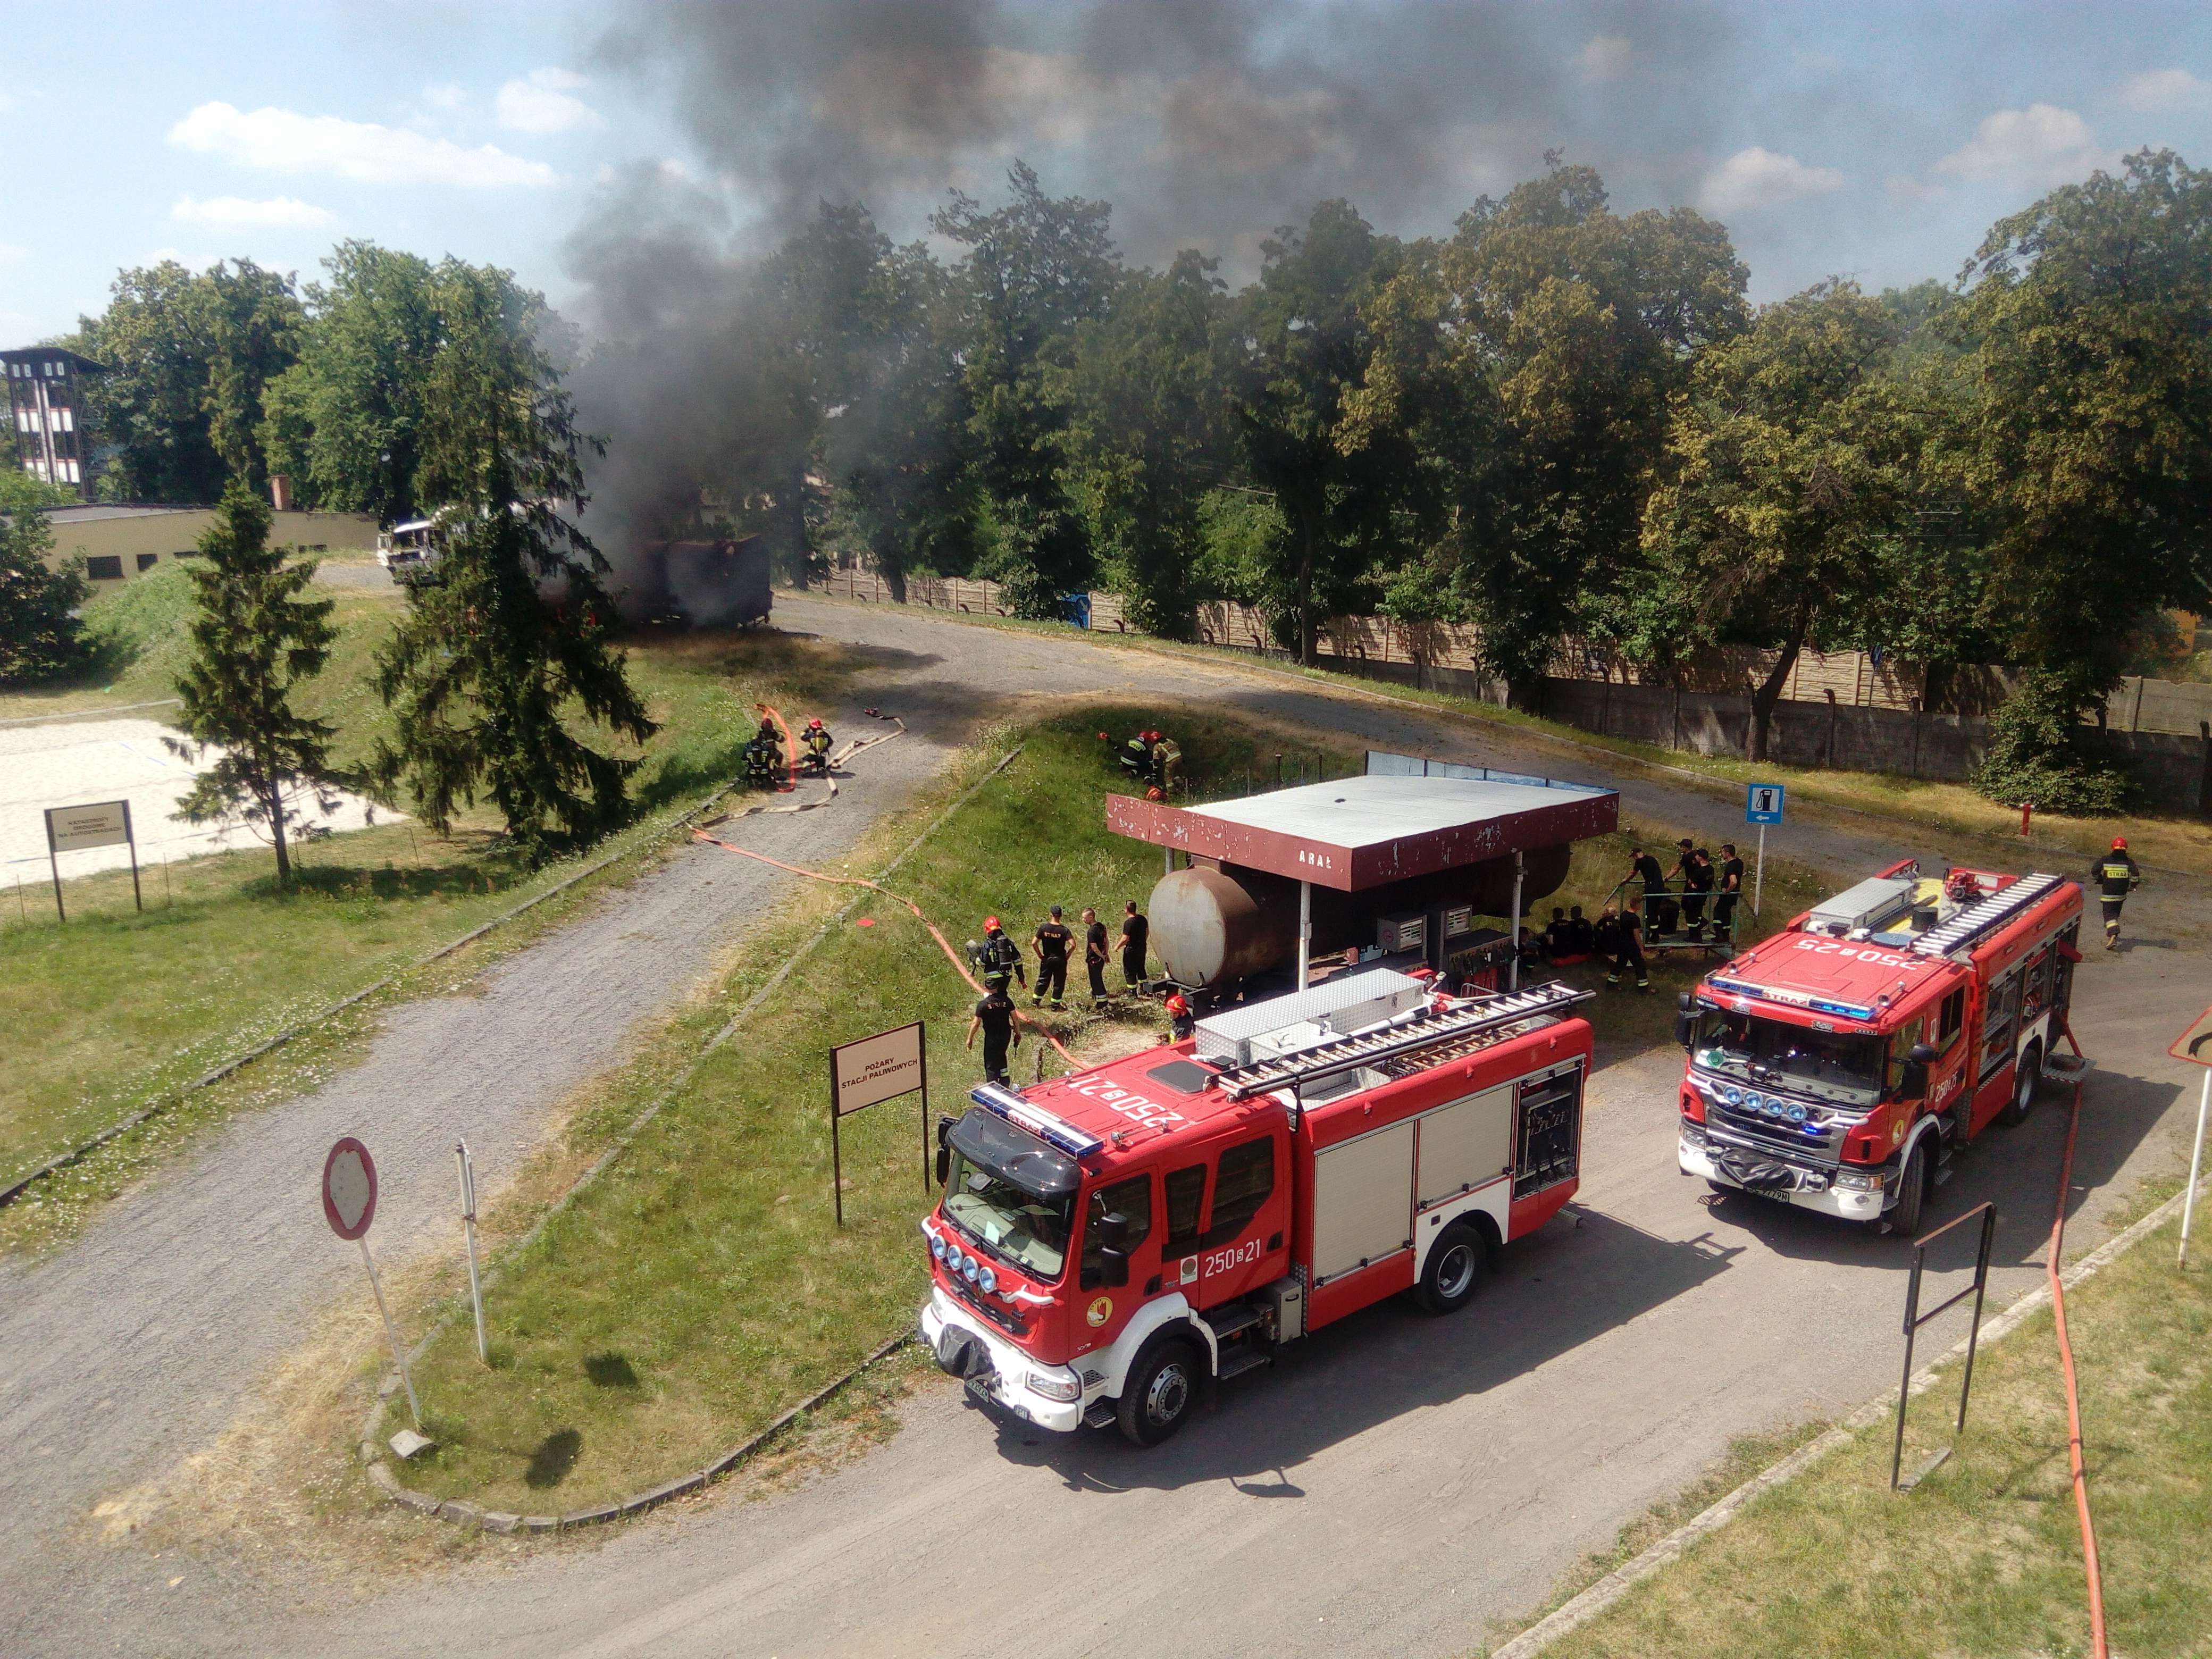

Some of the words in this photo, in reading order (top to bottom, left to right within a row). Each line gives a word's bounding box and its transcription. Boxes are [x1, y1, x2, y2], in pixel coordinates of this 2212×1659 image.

[842, 1075, 867, 1088] STACJI
[869, 1059, 917, 1079] PALIWOWYCH
[865, 1057, 894, 1071] POŻARY
[1205, 1238, 1261, 1278] 250S21
